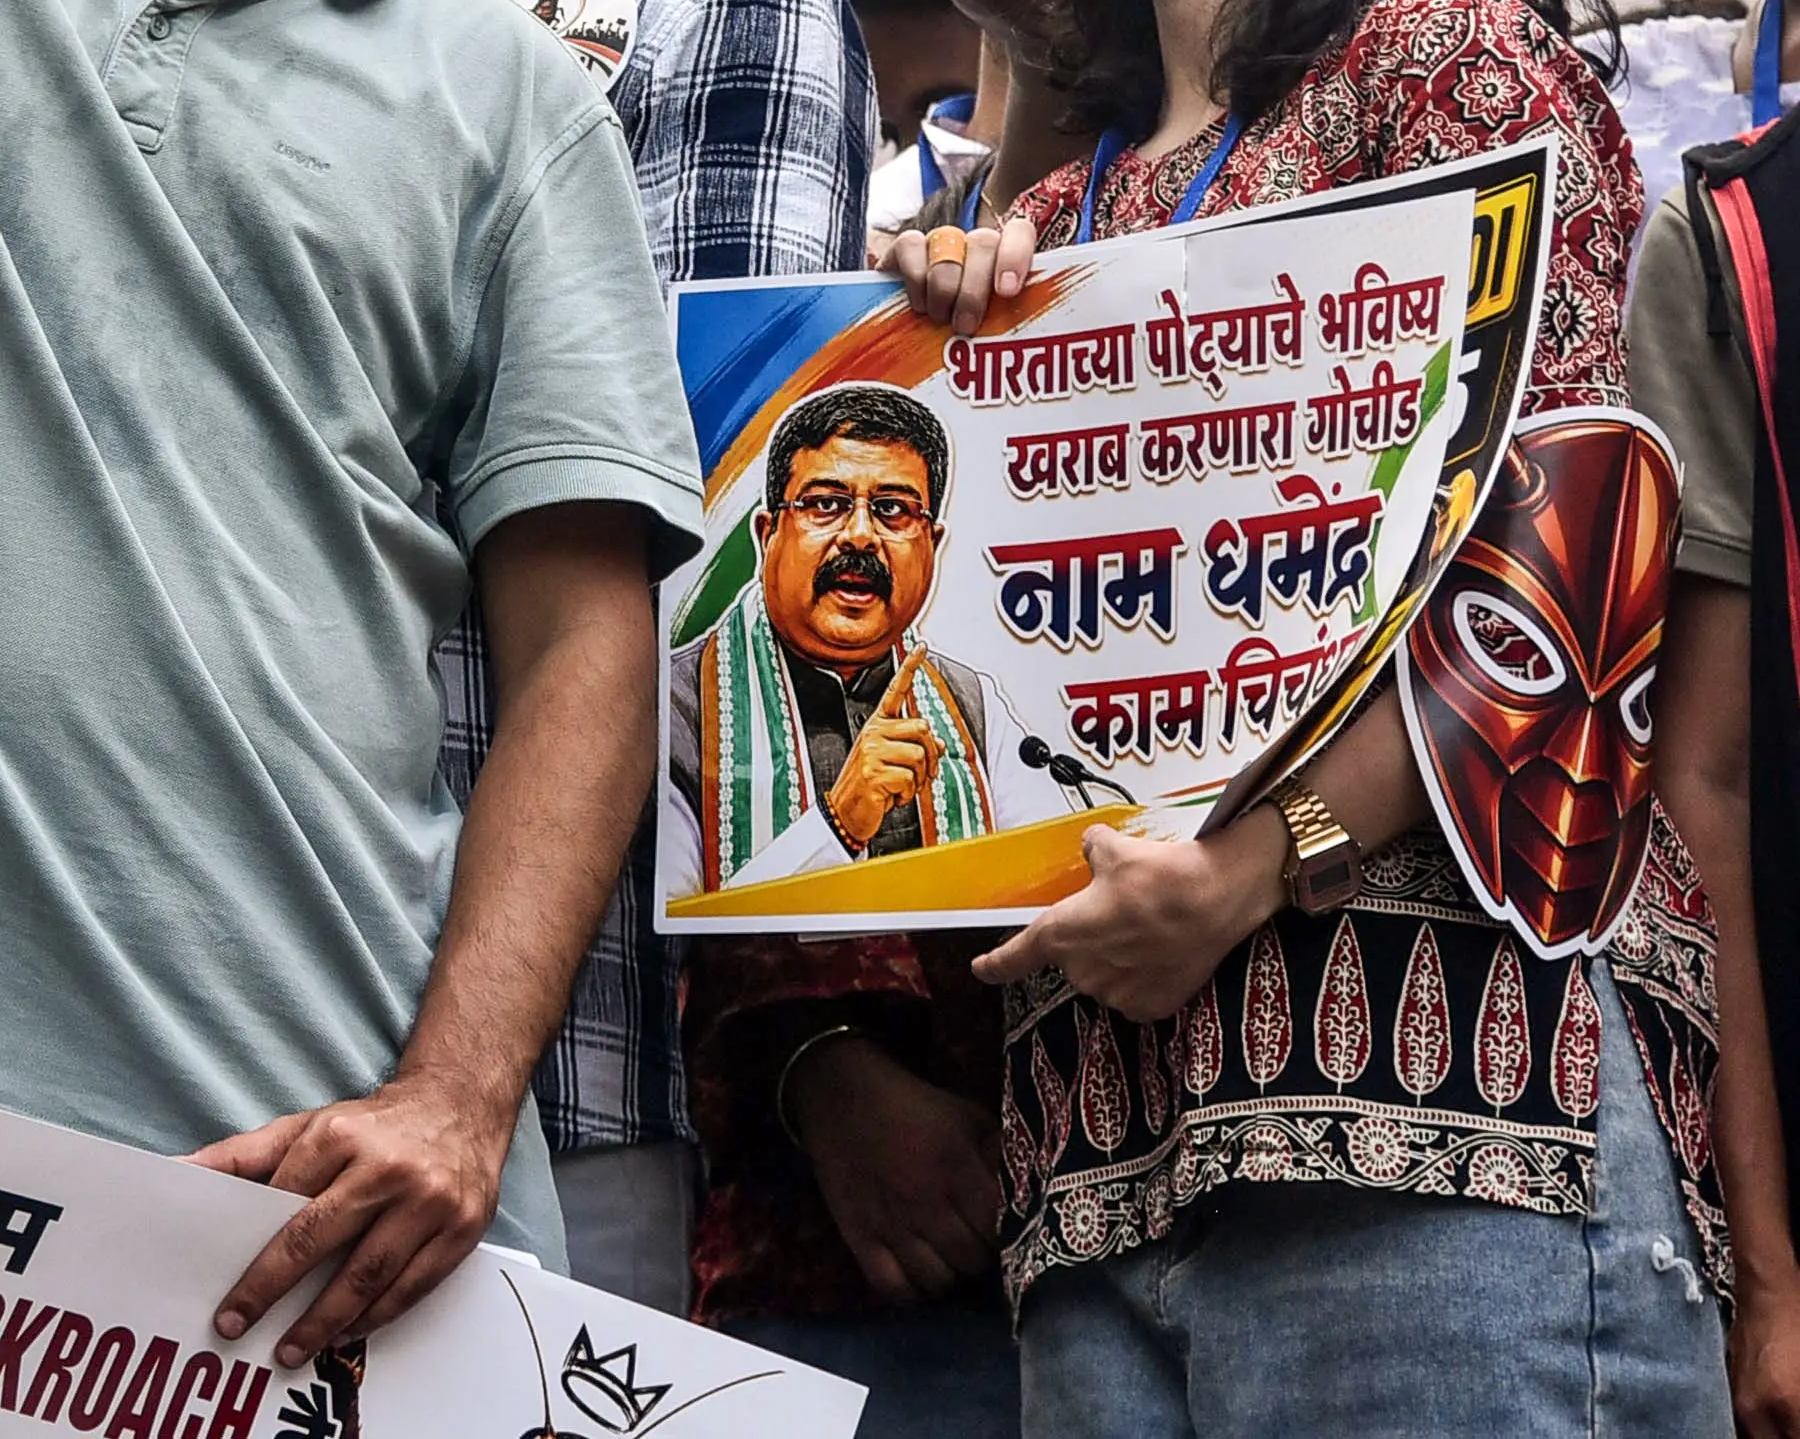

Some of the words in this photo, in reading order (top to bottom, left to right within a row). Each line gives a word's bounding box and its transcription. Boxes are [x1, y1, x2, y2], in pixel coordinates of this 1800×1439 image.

[949, 323, 1136, 401] भारताच्या
[1317, 262, 1446, 352] भविष्य
[1006, 423, 1129, 491] खराब
[1140, 400, 1296, 475] करणारा
[1306, 360, 1422, 455] गोचीड
[988, 527, 1183, 644] नाम
[1064, 670, 1209, 759] काम
